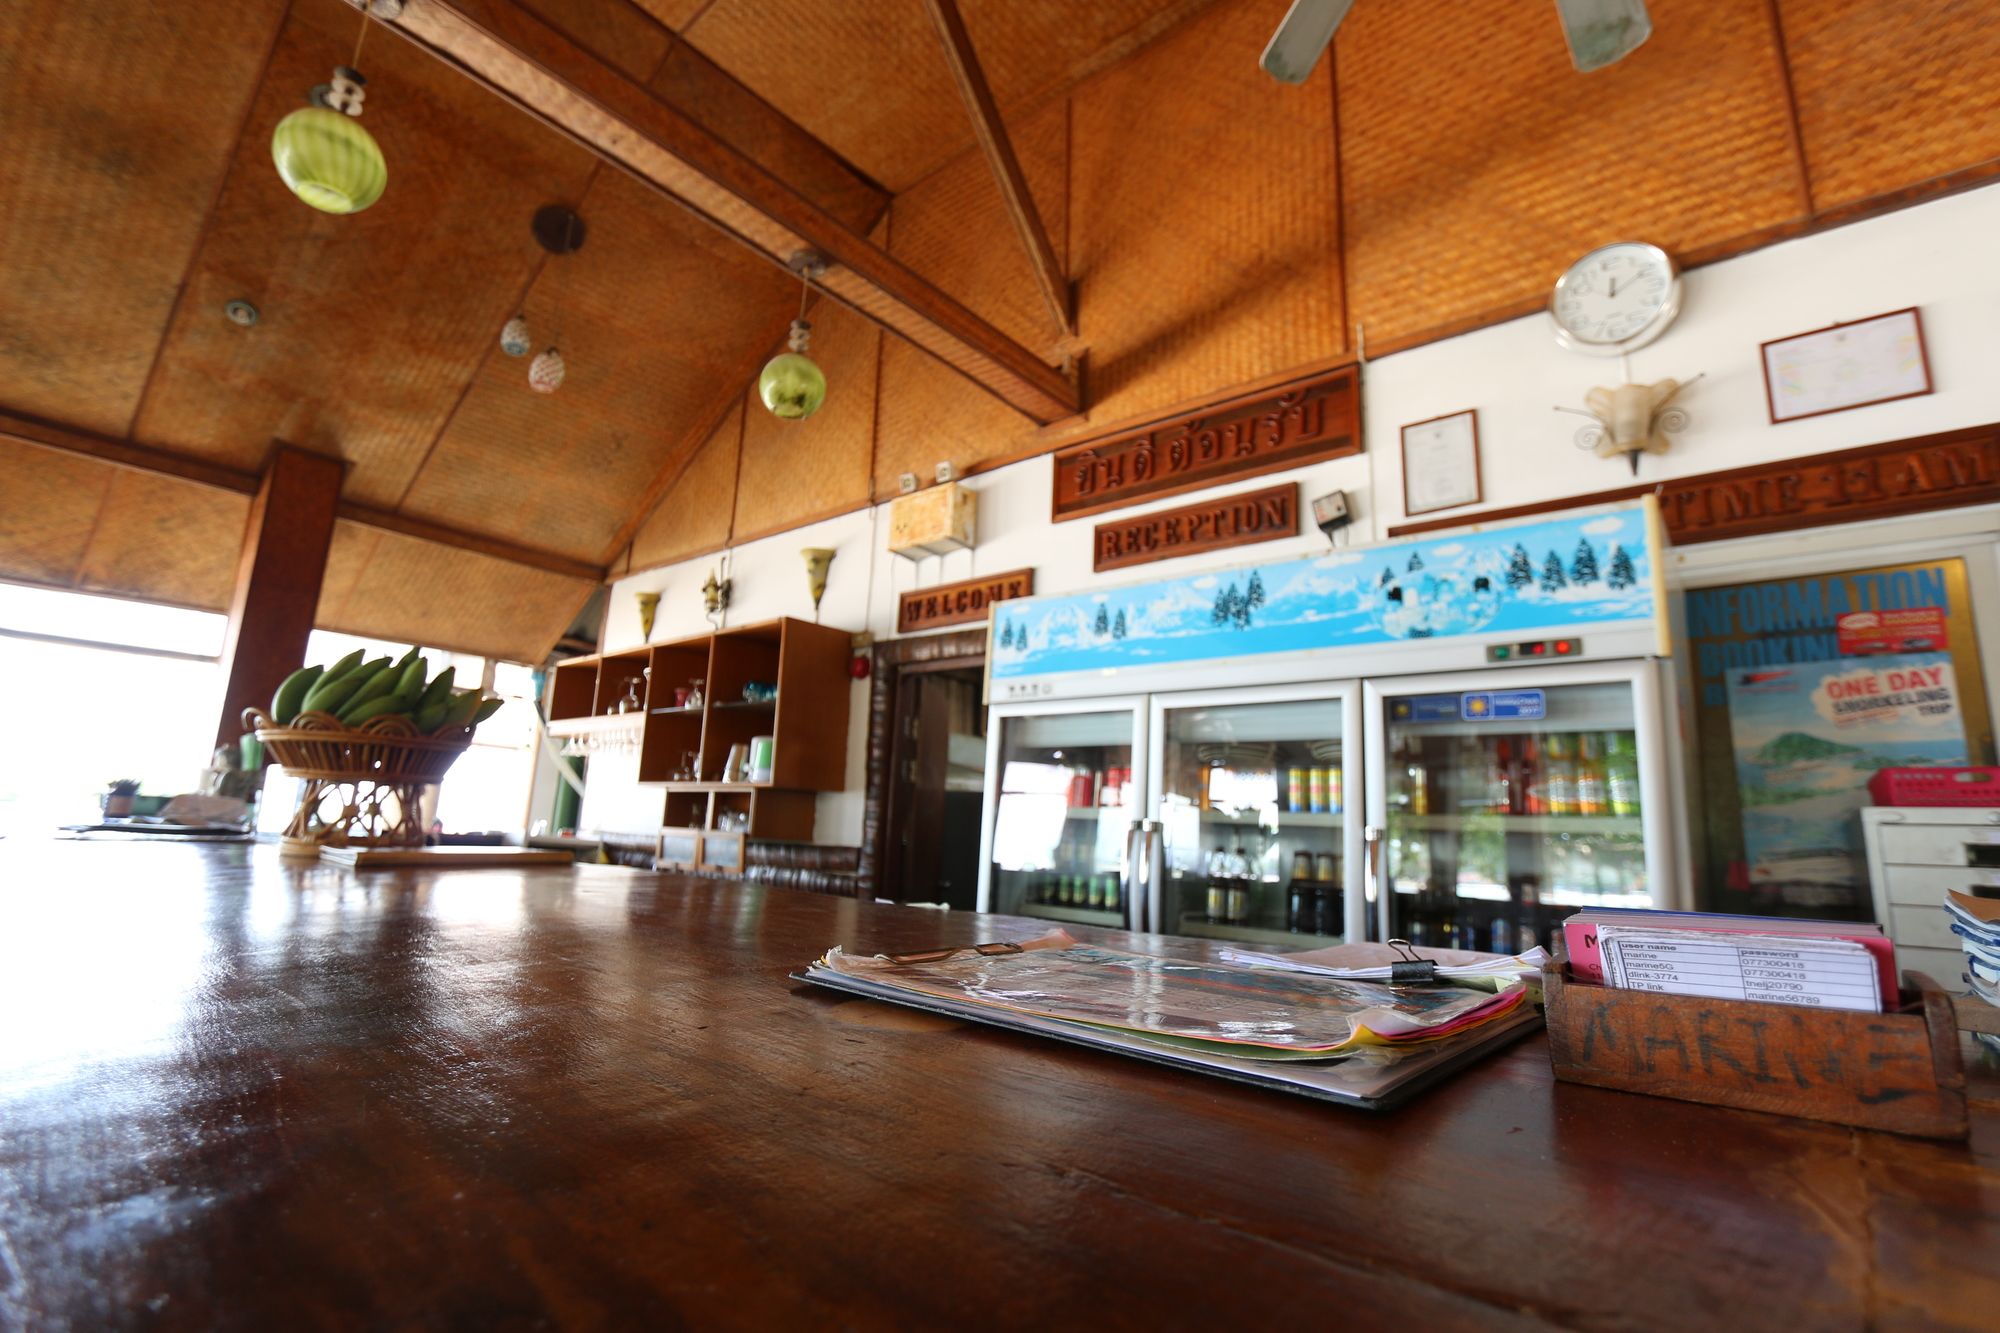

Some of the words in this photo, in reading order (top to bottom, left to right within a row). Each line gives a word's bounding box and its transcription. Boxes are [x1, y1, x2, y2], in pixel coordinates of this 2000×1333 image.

[1661, 471, 1805, 530] TIME
[1101, 496, 1288, 561] RECEPTION
[906, 581, 1022, 622] WELCOME
[1686, 567, 1950, 638] INFORMATION
[1699, 632, 1838, 676] BOOKIN
[1827, 675, 1881, 700] ONE
[1887, 666, 1943, 692] DAY
[1832, 687, 1951, 714] SNORKELING
[1621, 943, 1644, 951] user
[1624, 952, 1657, 960] marine
[1740, 950, 1799, 959] password
[1626, 960, 1674, 971] marine5G
[1628, 971, 1679, 981] dlink-3774
[1630, 981, 1644, 990] TP
[1646, 982, 1665, 991] link
[1748, 992, 1821, 1004] marine56789
[1582, 1000, 1922, 1104] MARINE
